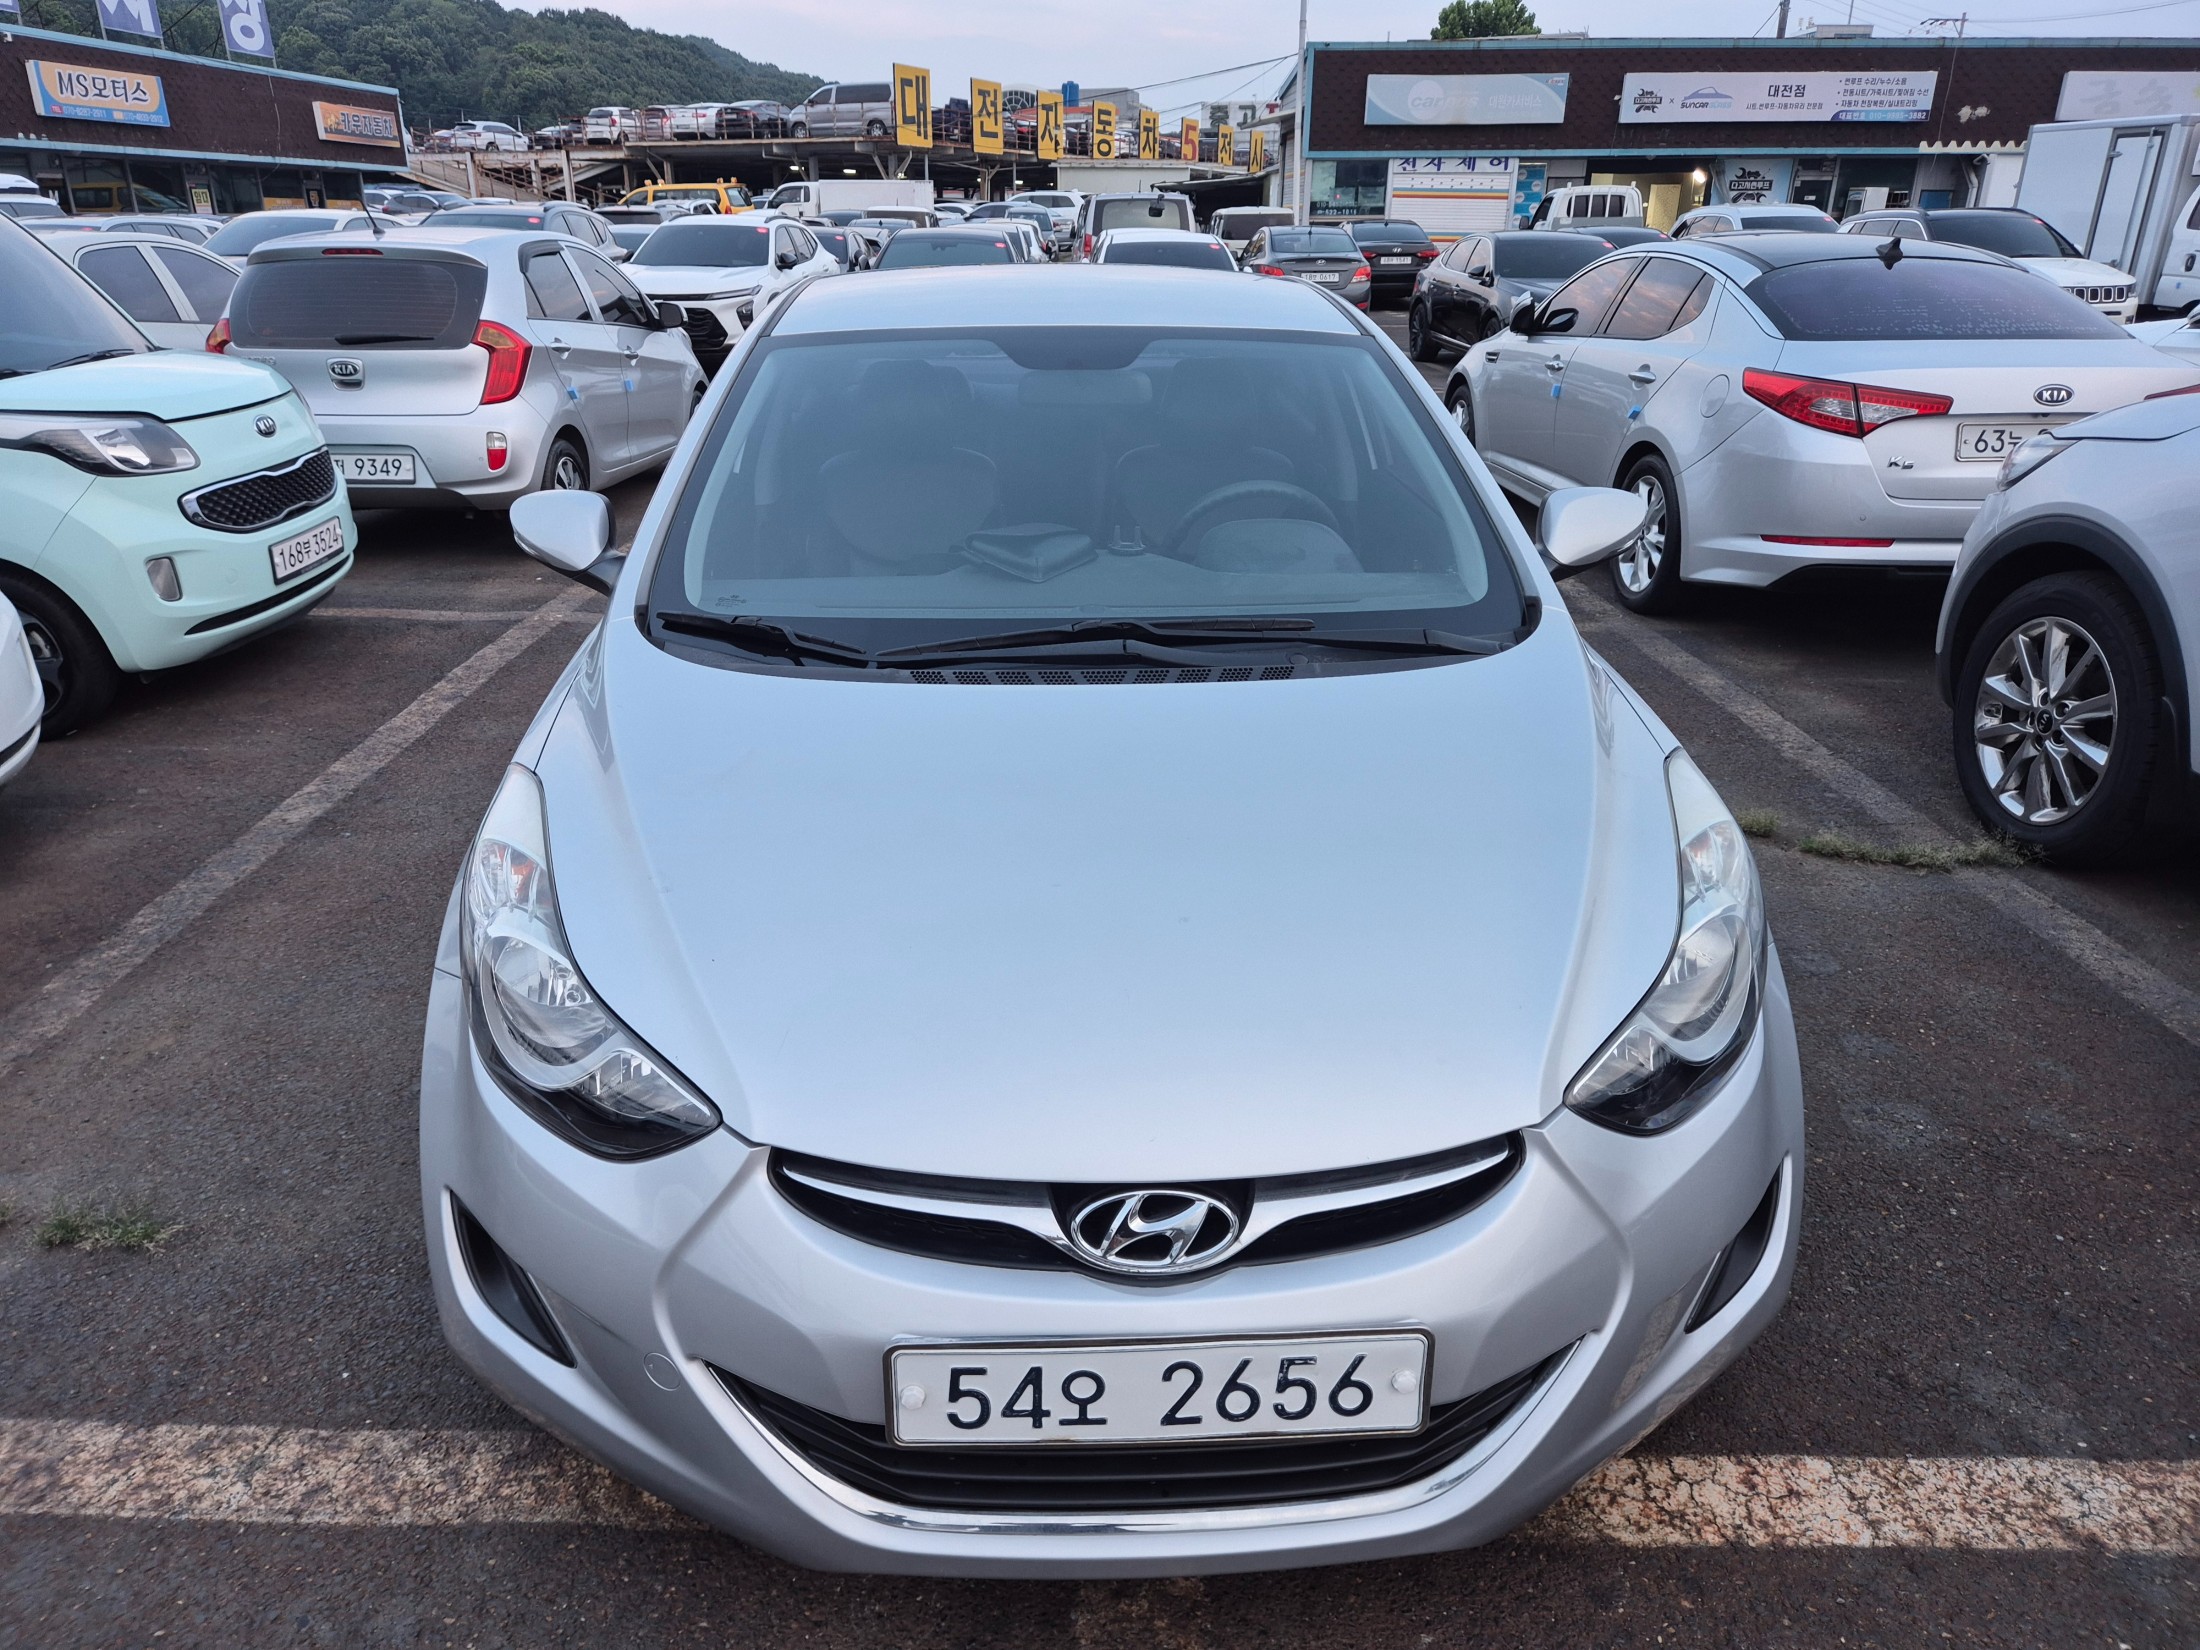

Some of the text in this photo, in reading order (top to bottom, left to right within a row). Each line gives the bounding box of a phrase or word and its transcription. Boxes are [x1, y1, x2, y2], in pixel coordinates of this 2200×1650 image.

[57, 71, 149, 103] MS모터스
[1767, 84, 1806, 98] 대전점
[340, 111, 394, 138] 카우자동차
[900, 75, 1263, 172] 대 전 자 동 차 5 전 시
[1320, 273, 1336, 281] 0617
[354, 457, 402, 477] 9349
[1887, 455, 1915, 470] K5
[279, 524, 339, 571] 168부 3524
[947, 1353, 1374, 1429] 54오 2656
